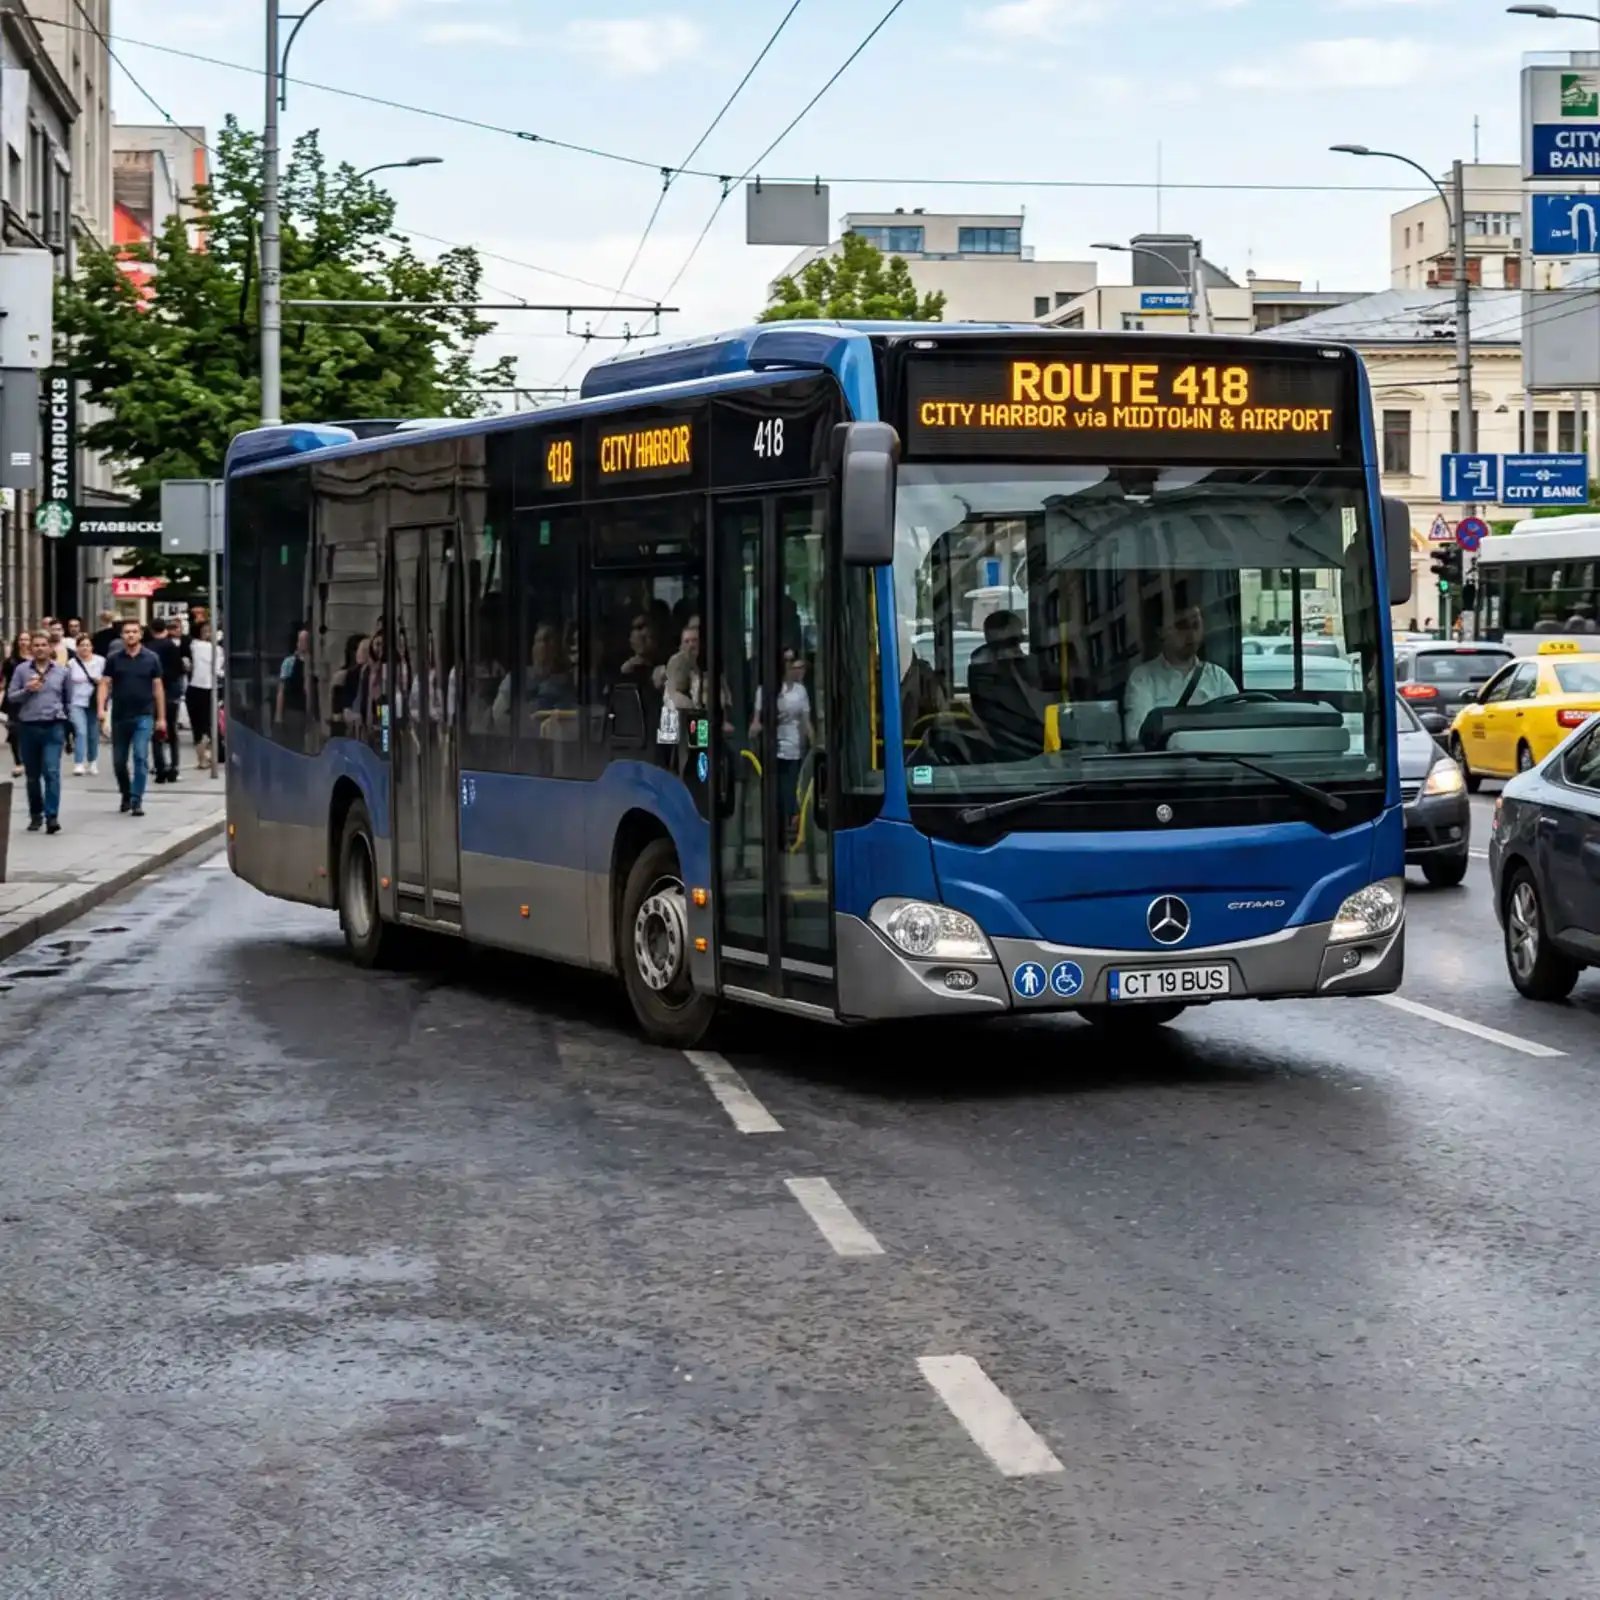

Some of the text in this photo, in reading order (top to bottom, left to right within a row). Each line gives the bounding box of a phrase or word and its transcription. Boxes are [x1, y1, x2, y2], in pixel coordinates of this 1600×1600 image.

[1555, 131, 1600, 149] CITY
[1012, 361, 1249, 406] ROUTE 418
[920, 402, 1333, 431] CITY HARBOR via MIDTOWN & AIRPORT
[752, 417, 785, 458] 418
[601, 432, 634, 473] CITY
[1507, 485, 1540, 498] CITY
[1125, 973, 1151, 994] CT
[1157, 972, 1177, 993] 19
[1182, 969, 1224, 991] BUS
